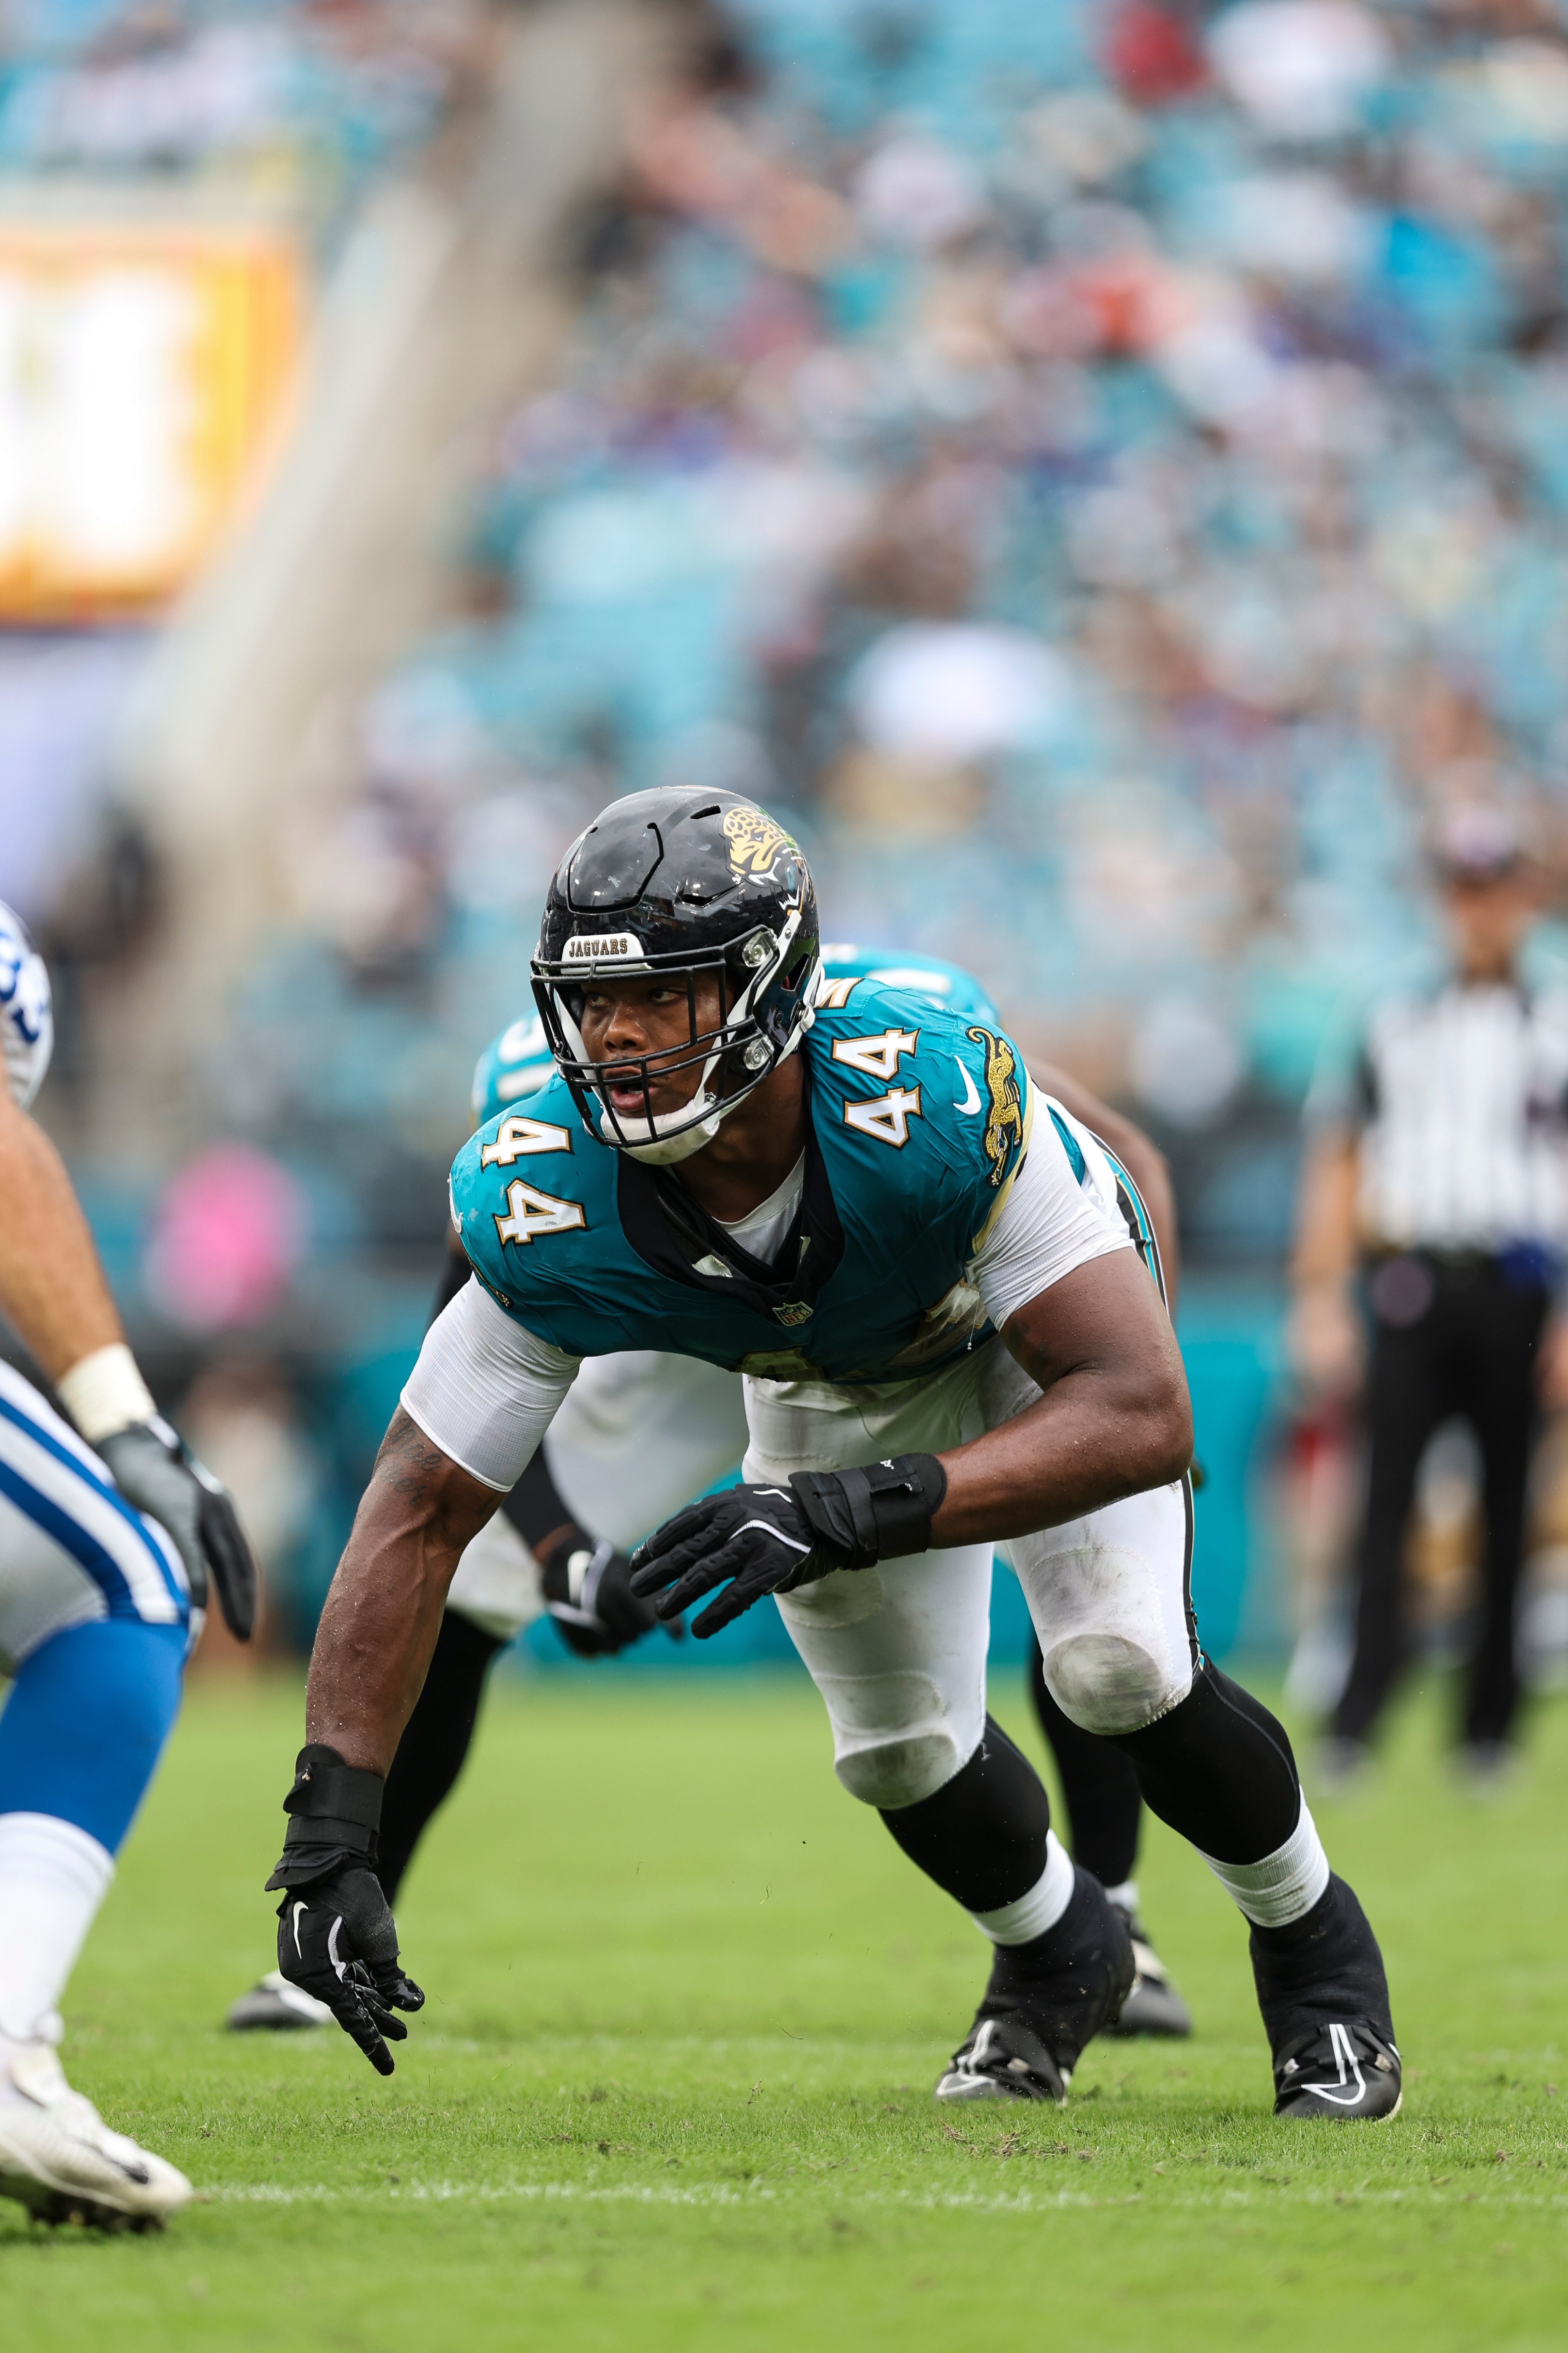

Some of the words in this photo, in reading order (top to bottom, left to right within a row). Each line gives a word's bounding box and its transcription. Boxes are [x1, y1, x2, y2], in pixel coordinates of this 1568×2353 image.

[569, 938, 627, 958] JAGUARS
[830, 1027, 924, 1150] 44
[481, 1116, 590, 1248] 44
[784, 1310, 808, 1324] NFL
